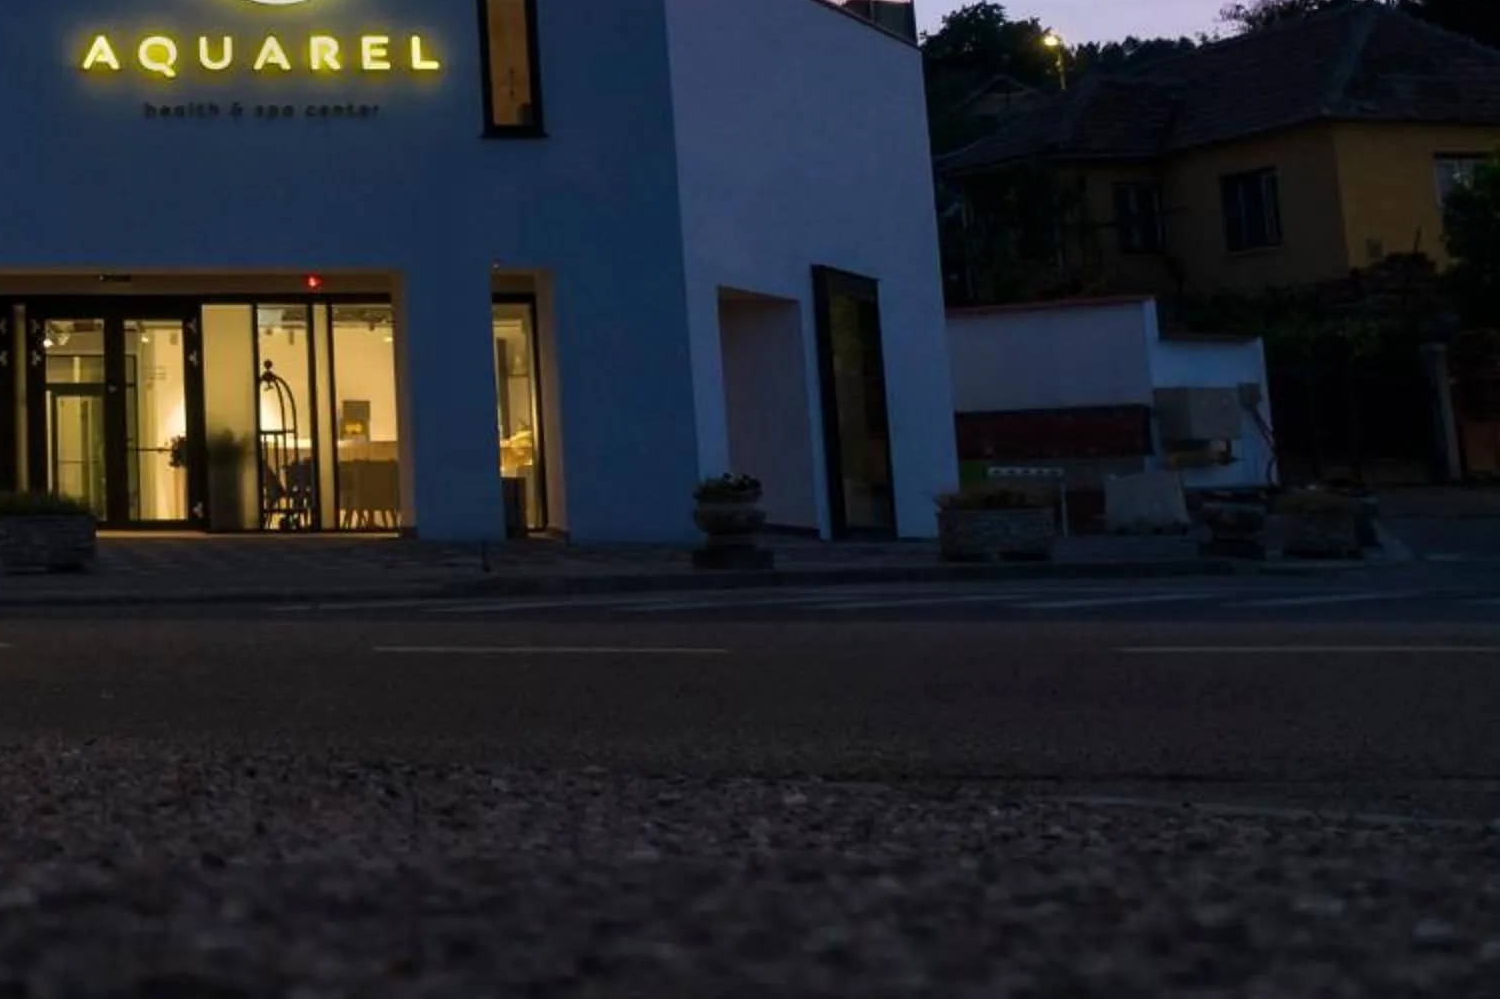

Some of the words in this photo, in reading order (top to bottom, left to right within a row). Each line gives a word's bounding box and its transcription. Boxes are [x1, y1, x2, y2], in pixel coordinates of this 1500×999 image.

[82, 34, 441, 78] AQUAREL
[144, 102, 220, 119] health
[255, 104, 295, 120] spa
[305, 102, 381, 118] center
